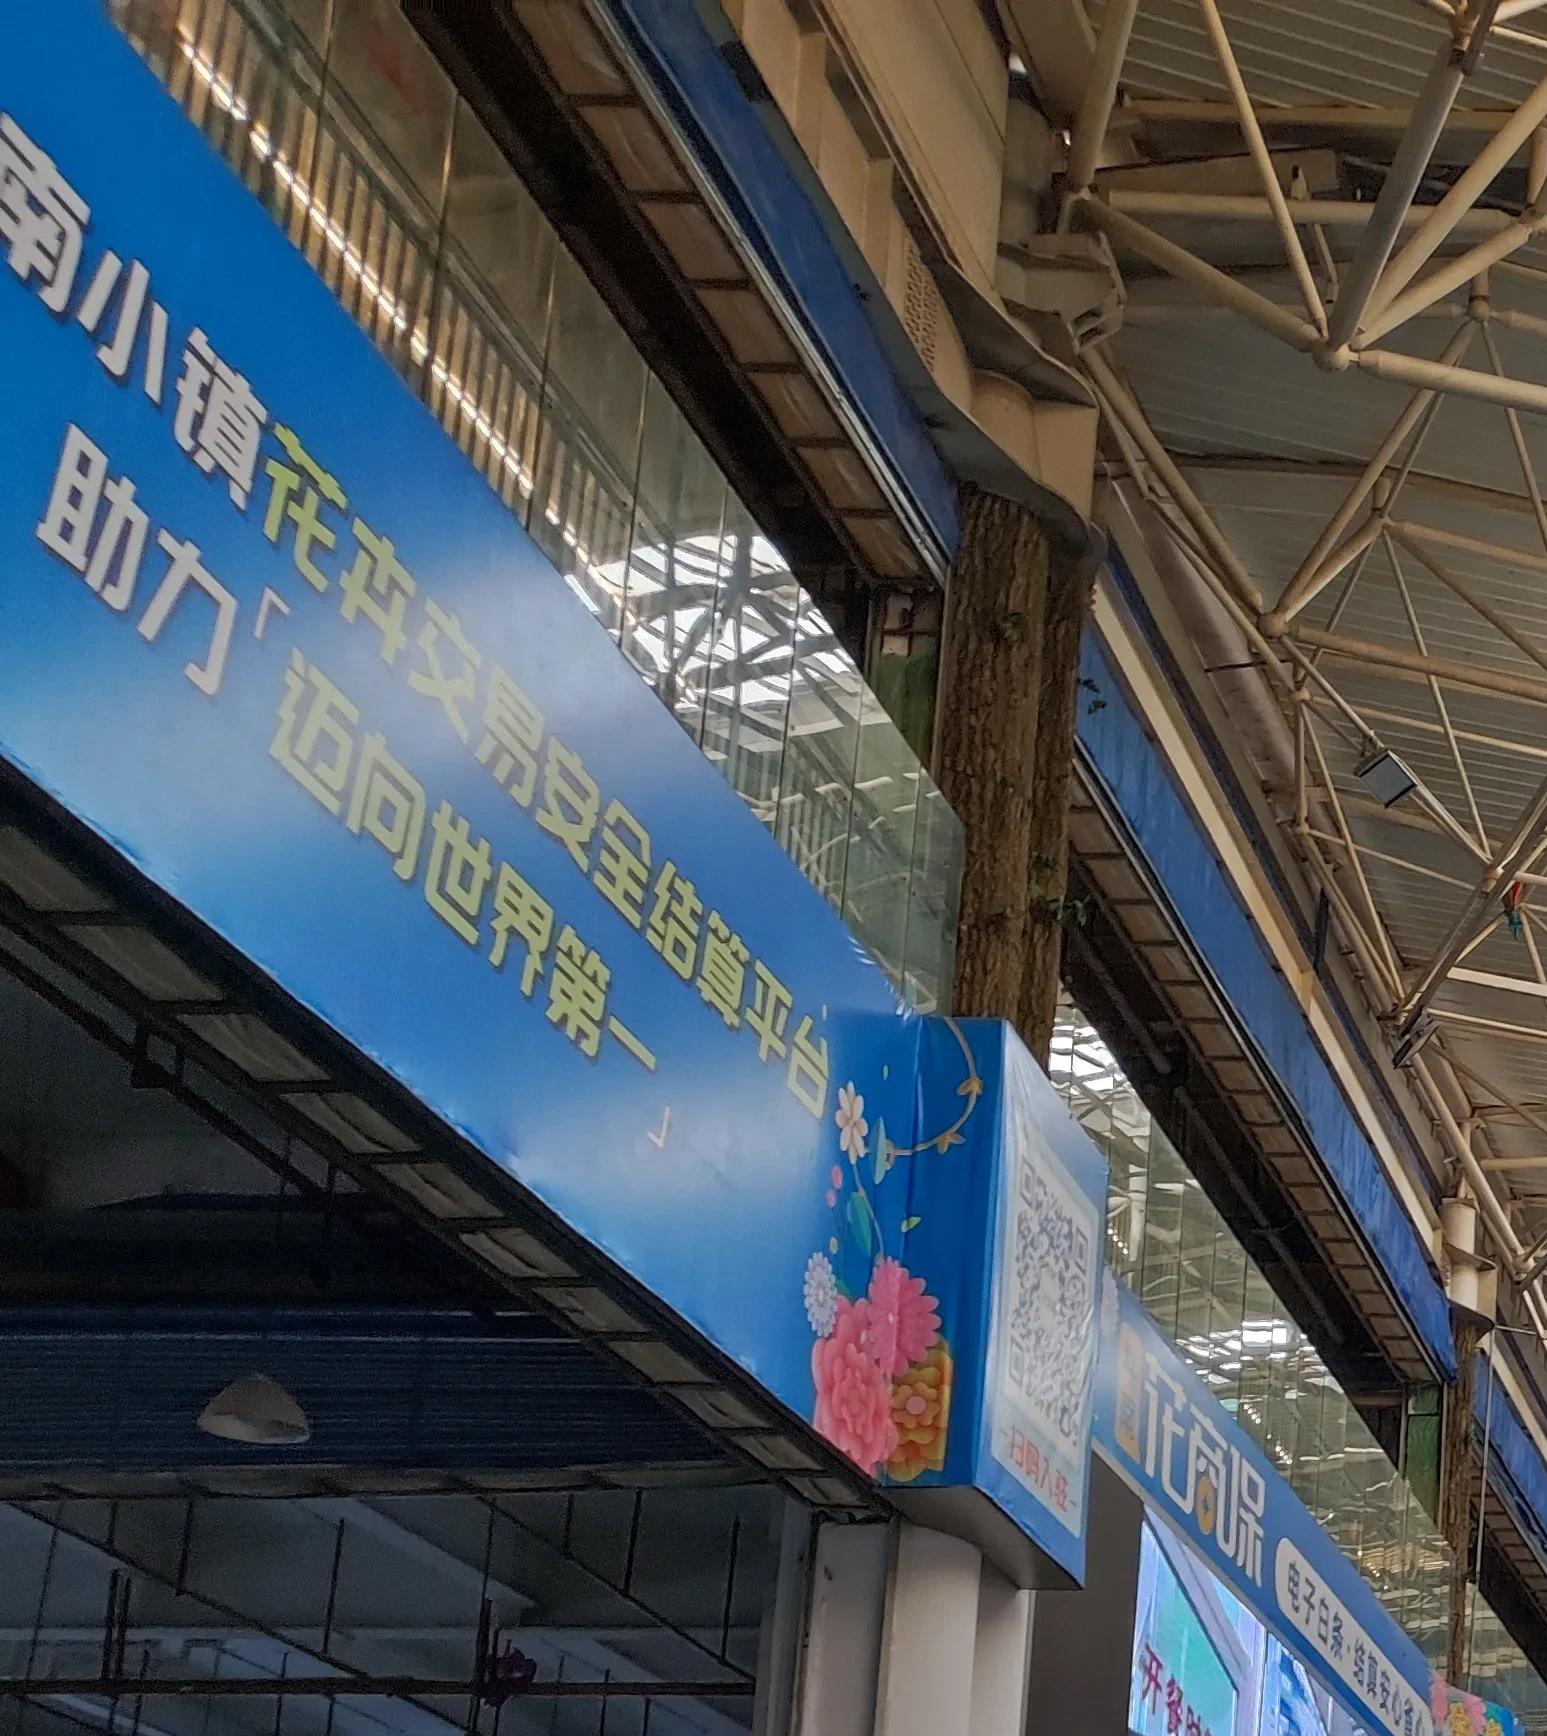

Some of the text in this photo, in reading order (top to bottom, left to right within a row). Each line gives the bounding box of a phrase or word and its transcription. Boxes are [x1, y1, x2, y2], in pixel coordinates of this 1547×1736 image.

[0, 111, 832, 1119] 南小镇花卉交易安全结算平台
